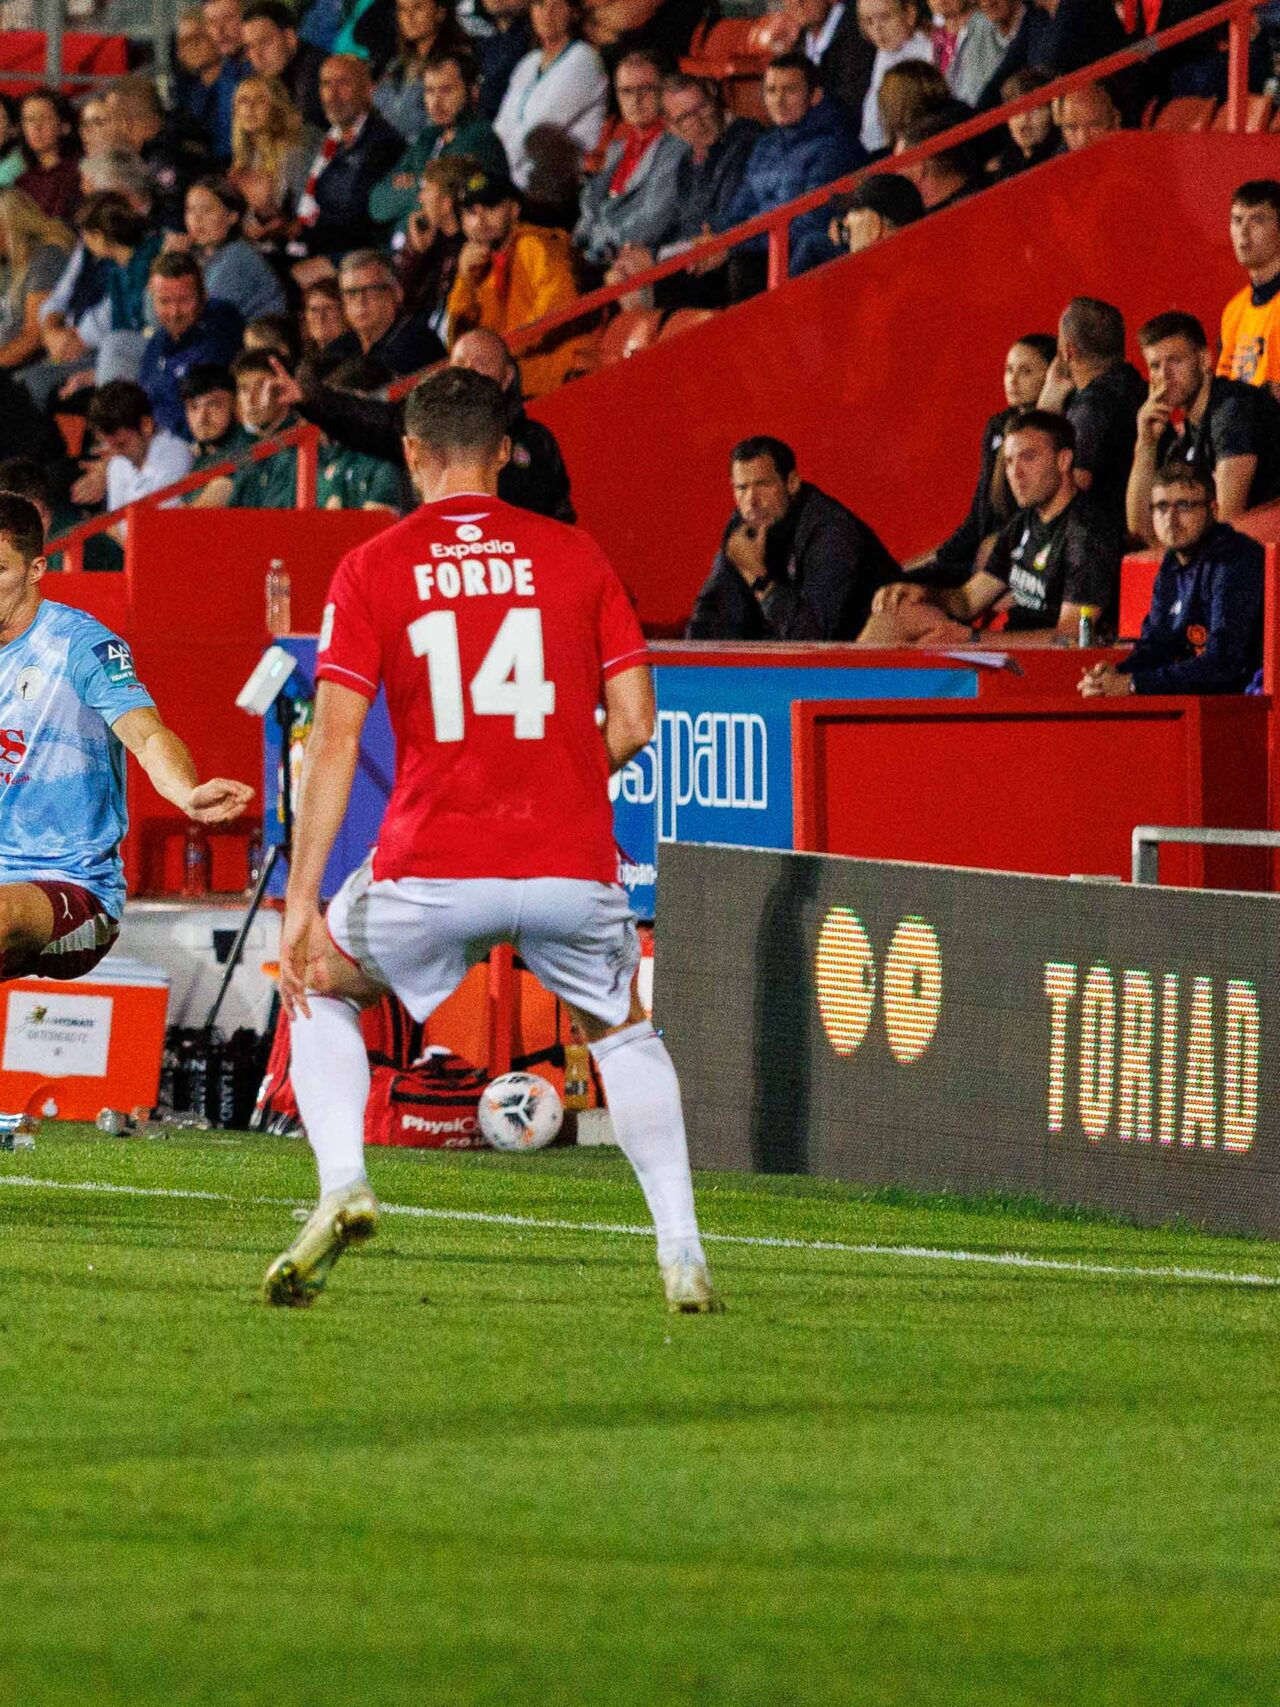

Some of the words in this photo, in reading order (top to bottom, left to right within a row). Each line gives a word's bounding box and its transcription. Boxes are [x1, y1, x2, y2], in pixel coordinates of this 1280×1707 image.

[414, 558, 535, 600] FORDE
[430, 540, 515, 560] Expedia
[407, 608, 555, 743] 14
[1045, 961, 1260, 1153] TORIAD
